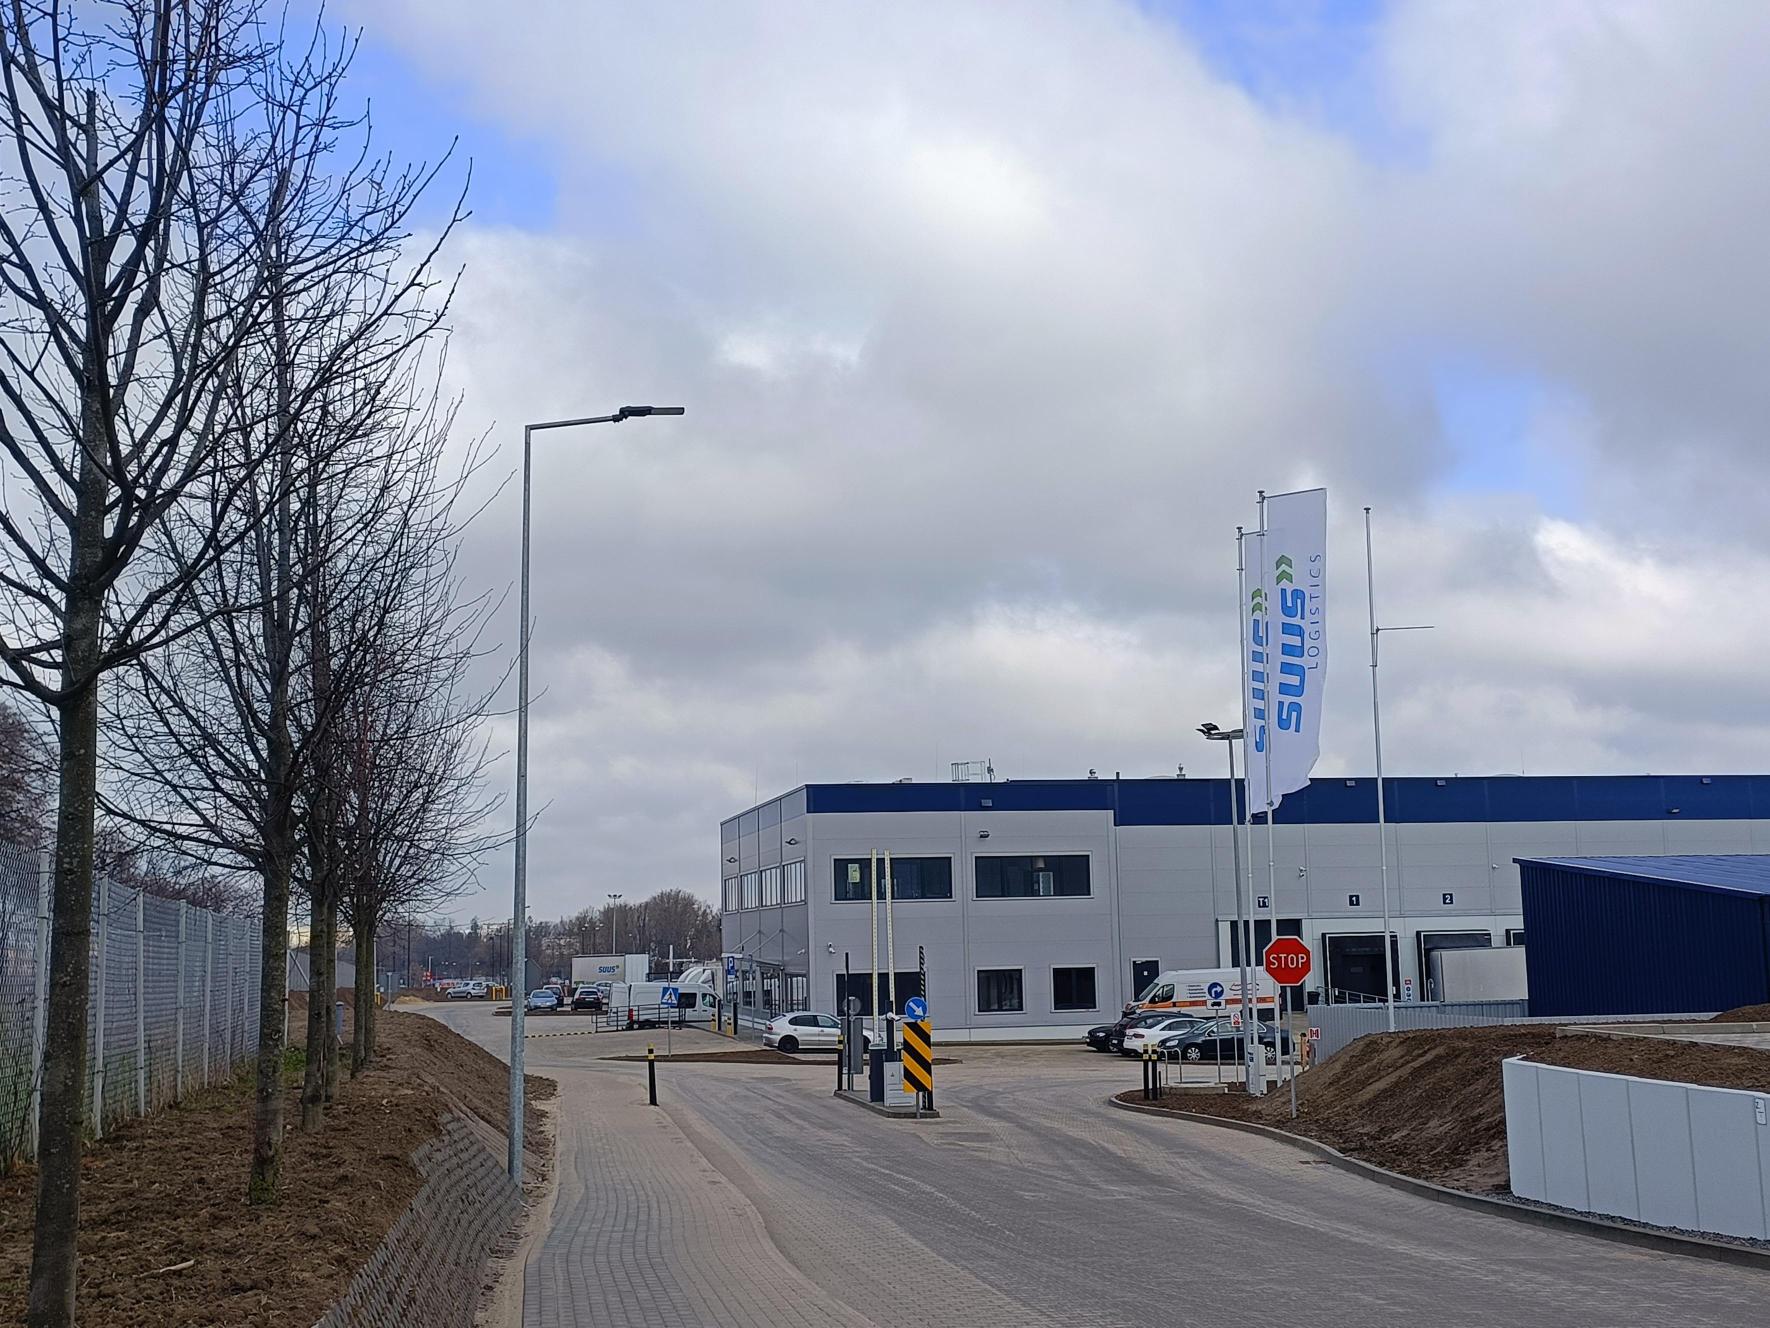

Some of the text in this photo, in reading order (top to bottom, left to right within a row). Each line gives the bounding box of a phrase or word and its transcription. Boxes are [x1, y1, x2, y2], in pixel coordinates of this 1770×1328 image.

[1307, 554, 1322, 671] LOGISTICS
[1258, 898, 1269, 907] T1
[1351, 896, 1357, 905] 1
[1445, 894, 1452, 903] 2
[728, 957, 734, 970] P
[1269, 953, 1307, 969] STOP
